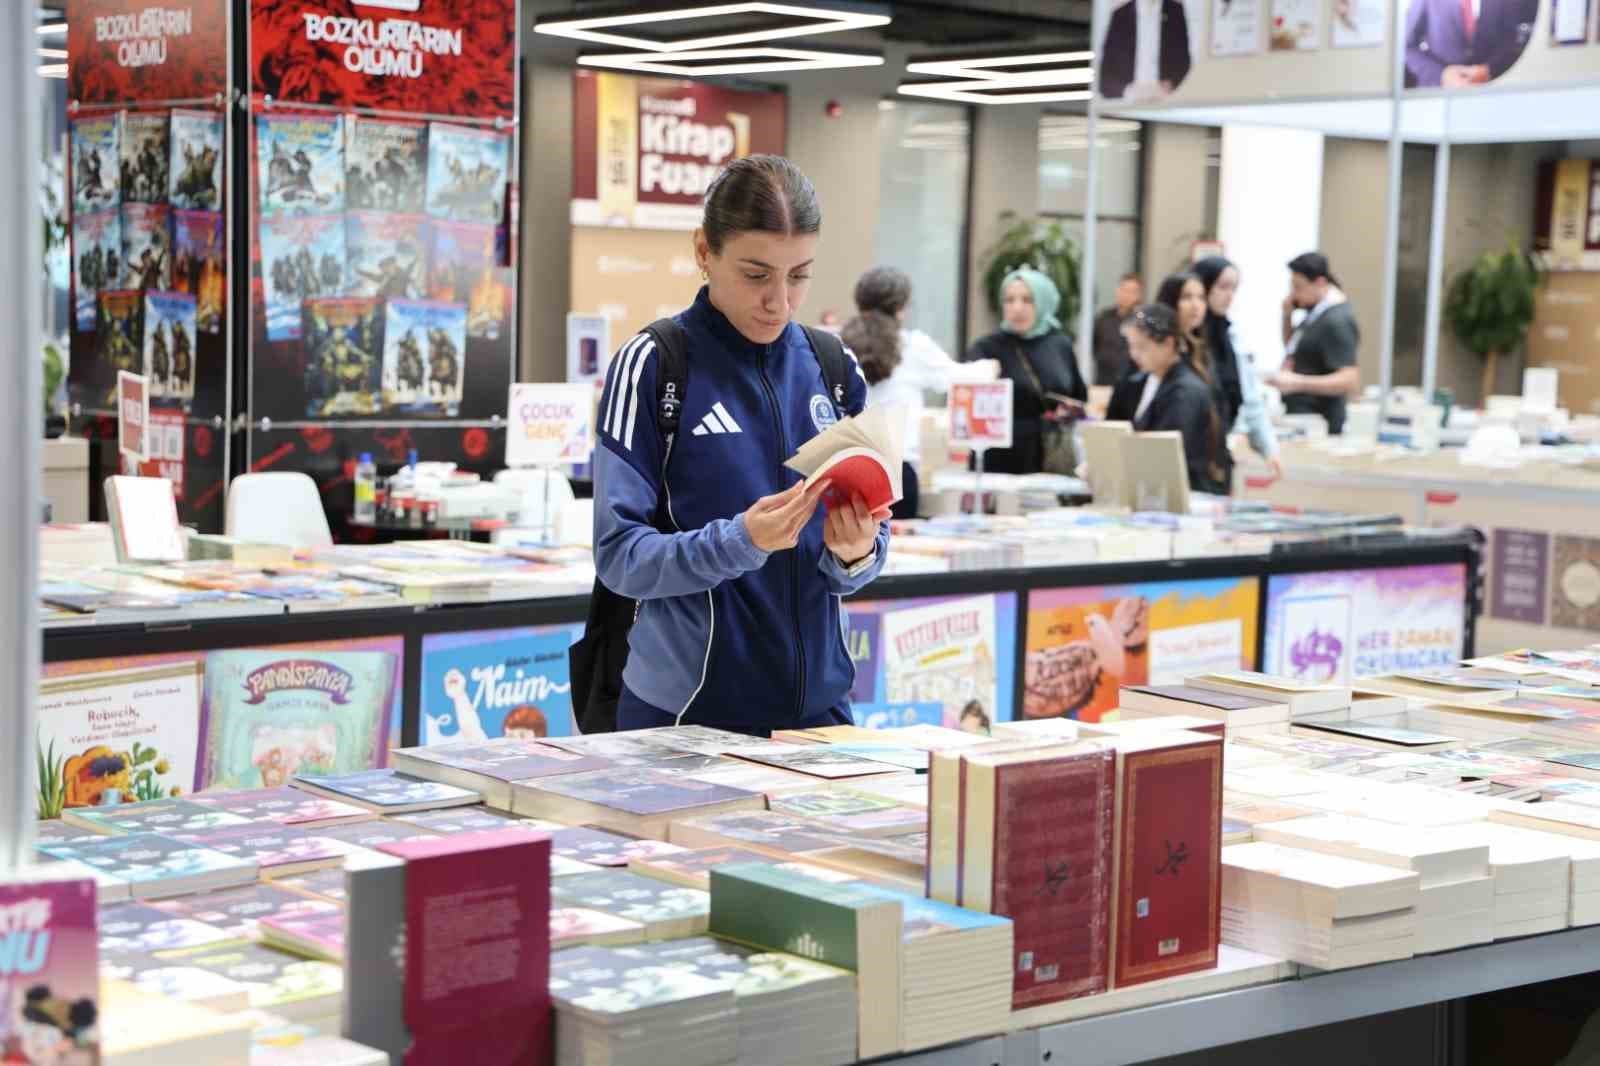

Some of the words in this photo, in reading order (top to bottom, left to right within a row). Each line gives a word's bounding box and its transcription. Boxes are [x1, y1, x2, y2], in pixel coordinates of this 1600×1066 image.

[640, 113, 736, 163] Kitap
[640, 154, 726, 196] Fuar
[471, 664, 562, 710] Naim
